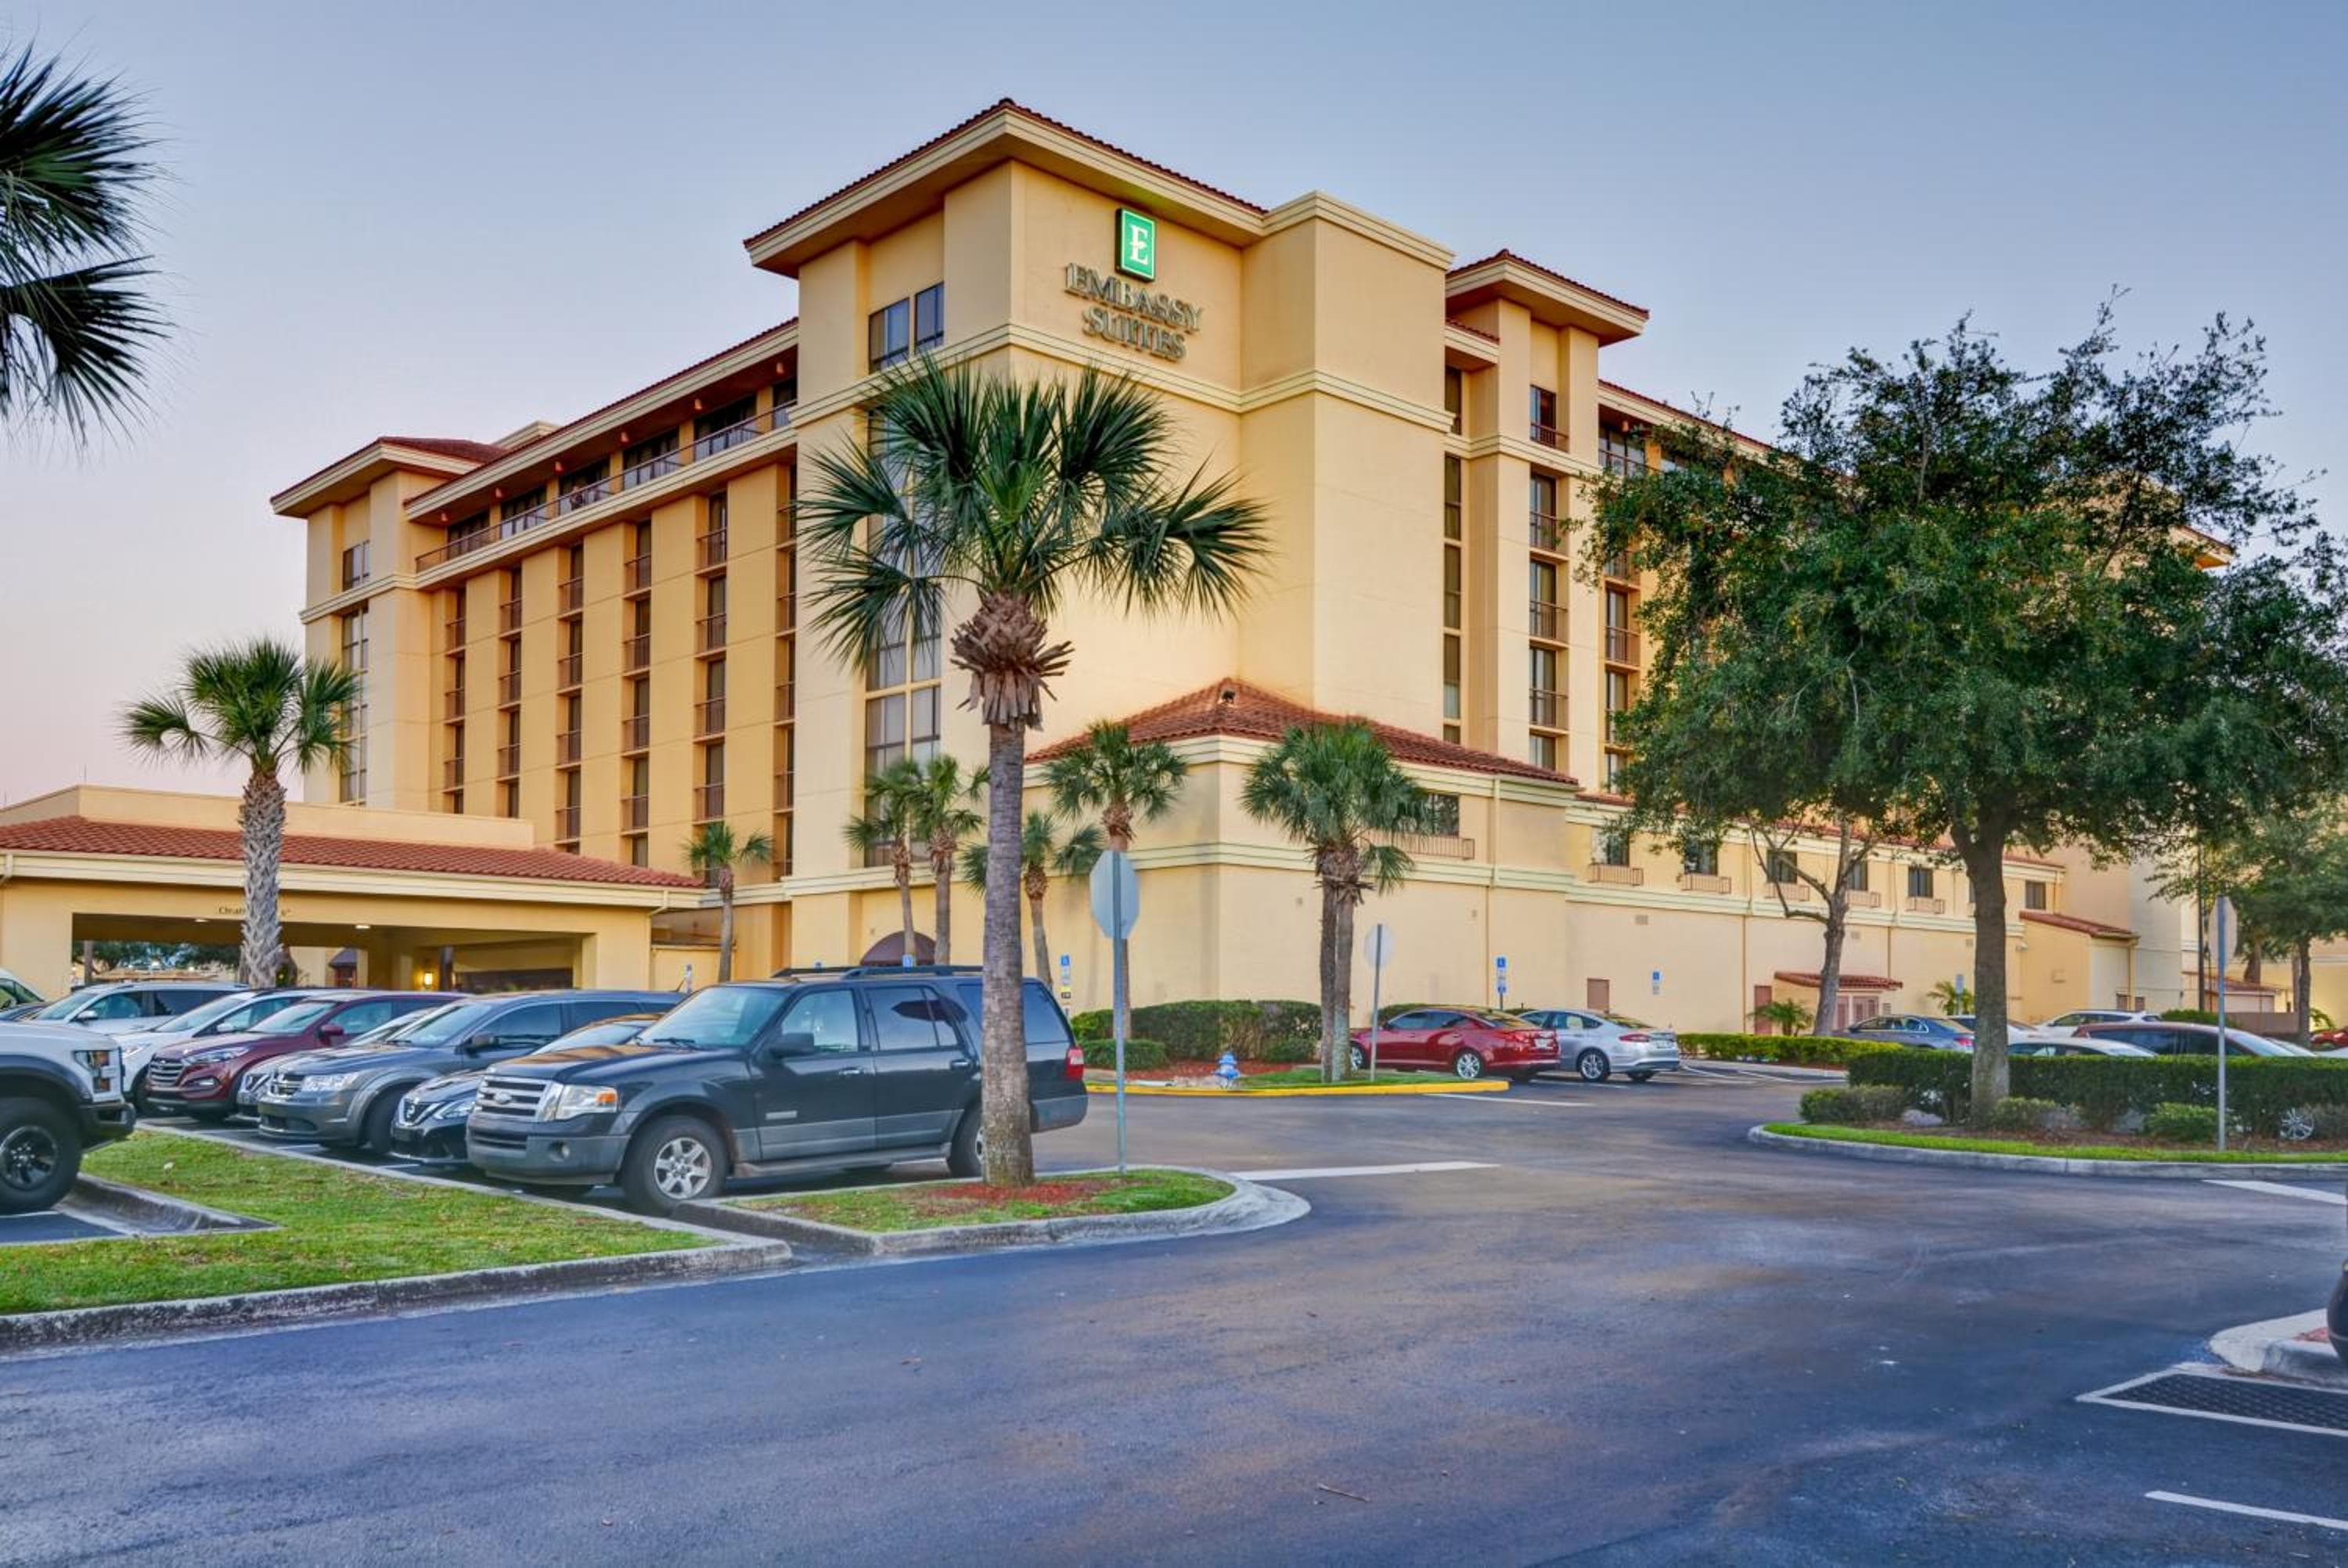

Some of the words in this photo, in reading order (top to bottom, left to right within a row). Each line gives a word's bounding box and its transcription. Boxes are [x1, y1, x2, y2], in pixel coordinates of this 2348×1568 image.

[1129, 225, 1148, 265] E
[1065, 262, 1203, 331] EMBASSY
[1082, 306, 1187, 361] SUITES
